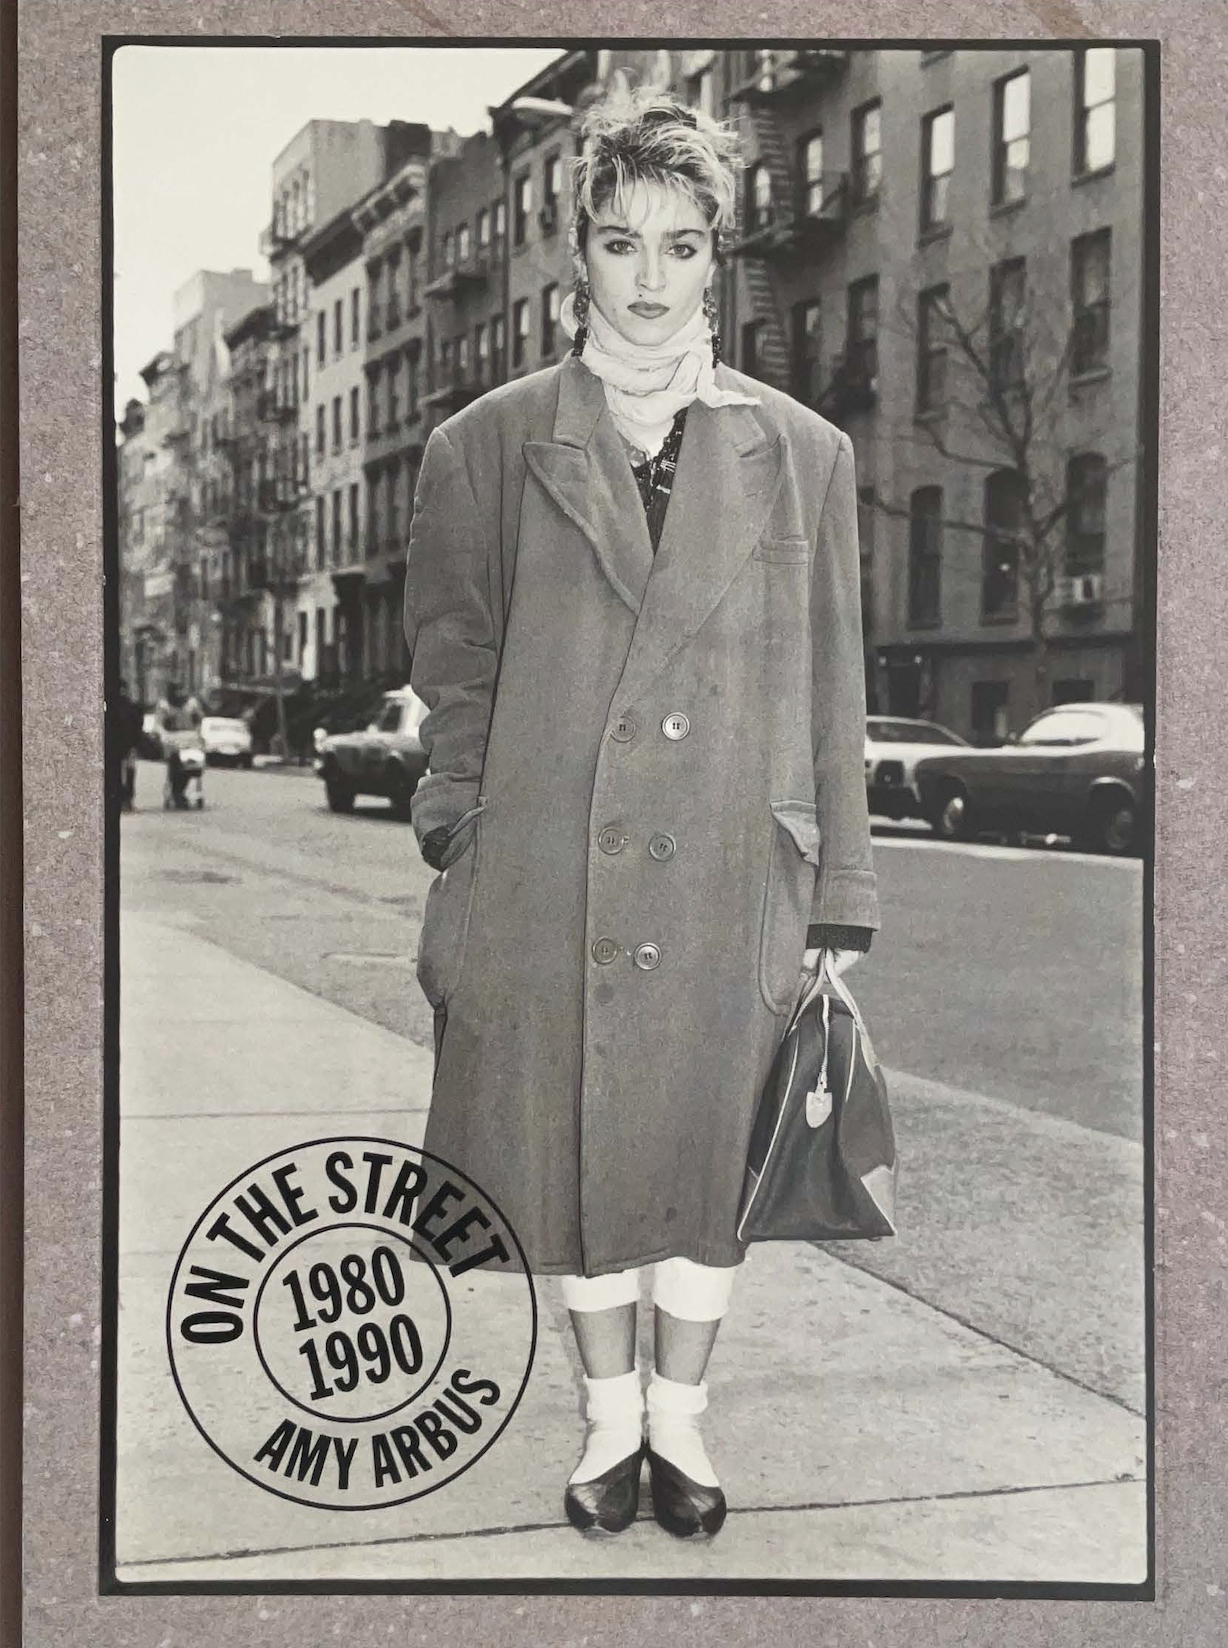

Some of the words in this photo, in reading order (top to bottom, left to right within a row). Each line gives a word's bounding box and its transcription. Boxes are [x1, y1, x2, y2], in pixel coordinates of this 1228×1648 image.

[205, 1162, 319, 1263] THE
[325, 1151, 510, 1277] STREET
[180, 1265, 250, 1344] ON
[282, 1246, 405, 1332] 1980
[299, 1313, 423, 1401] 1990
[253, 1419, 359, 1490] AMY
[371, 1368, 501, 1488] ARBUS
